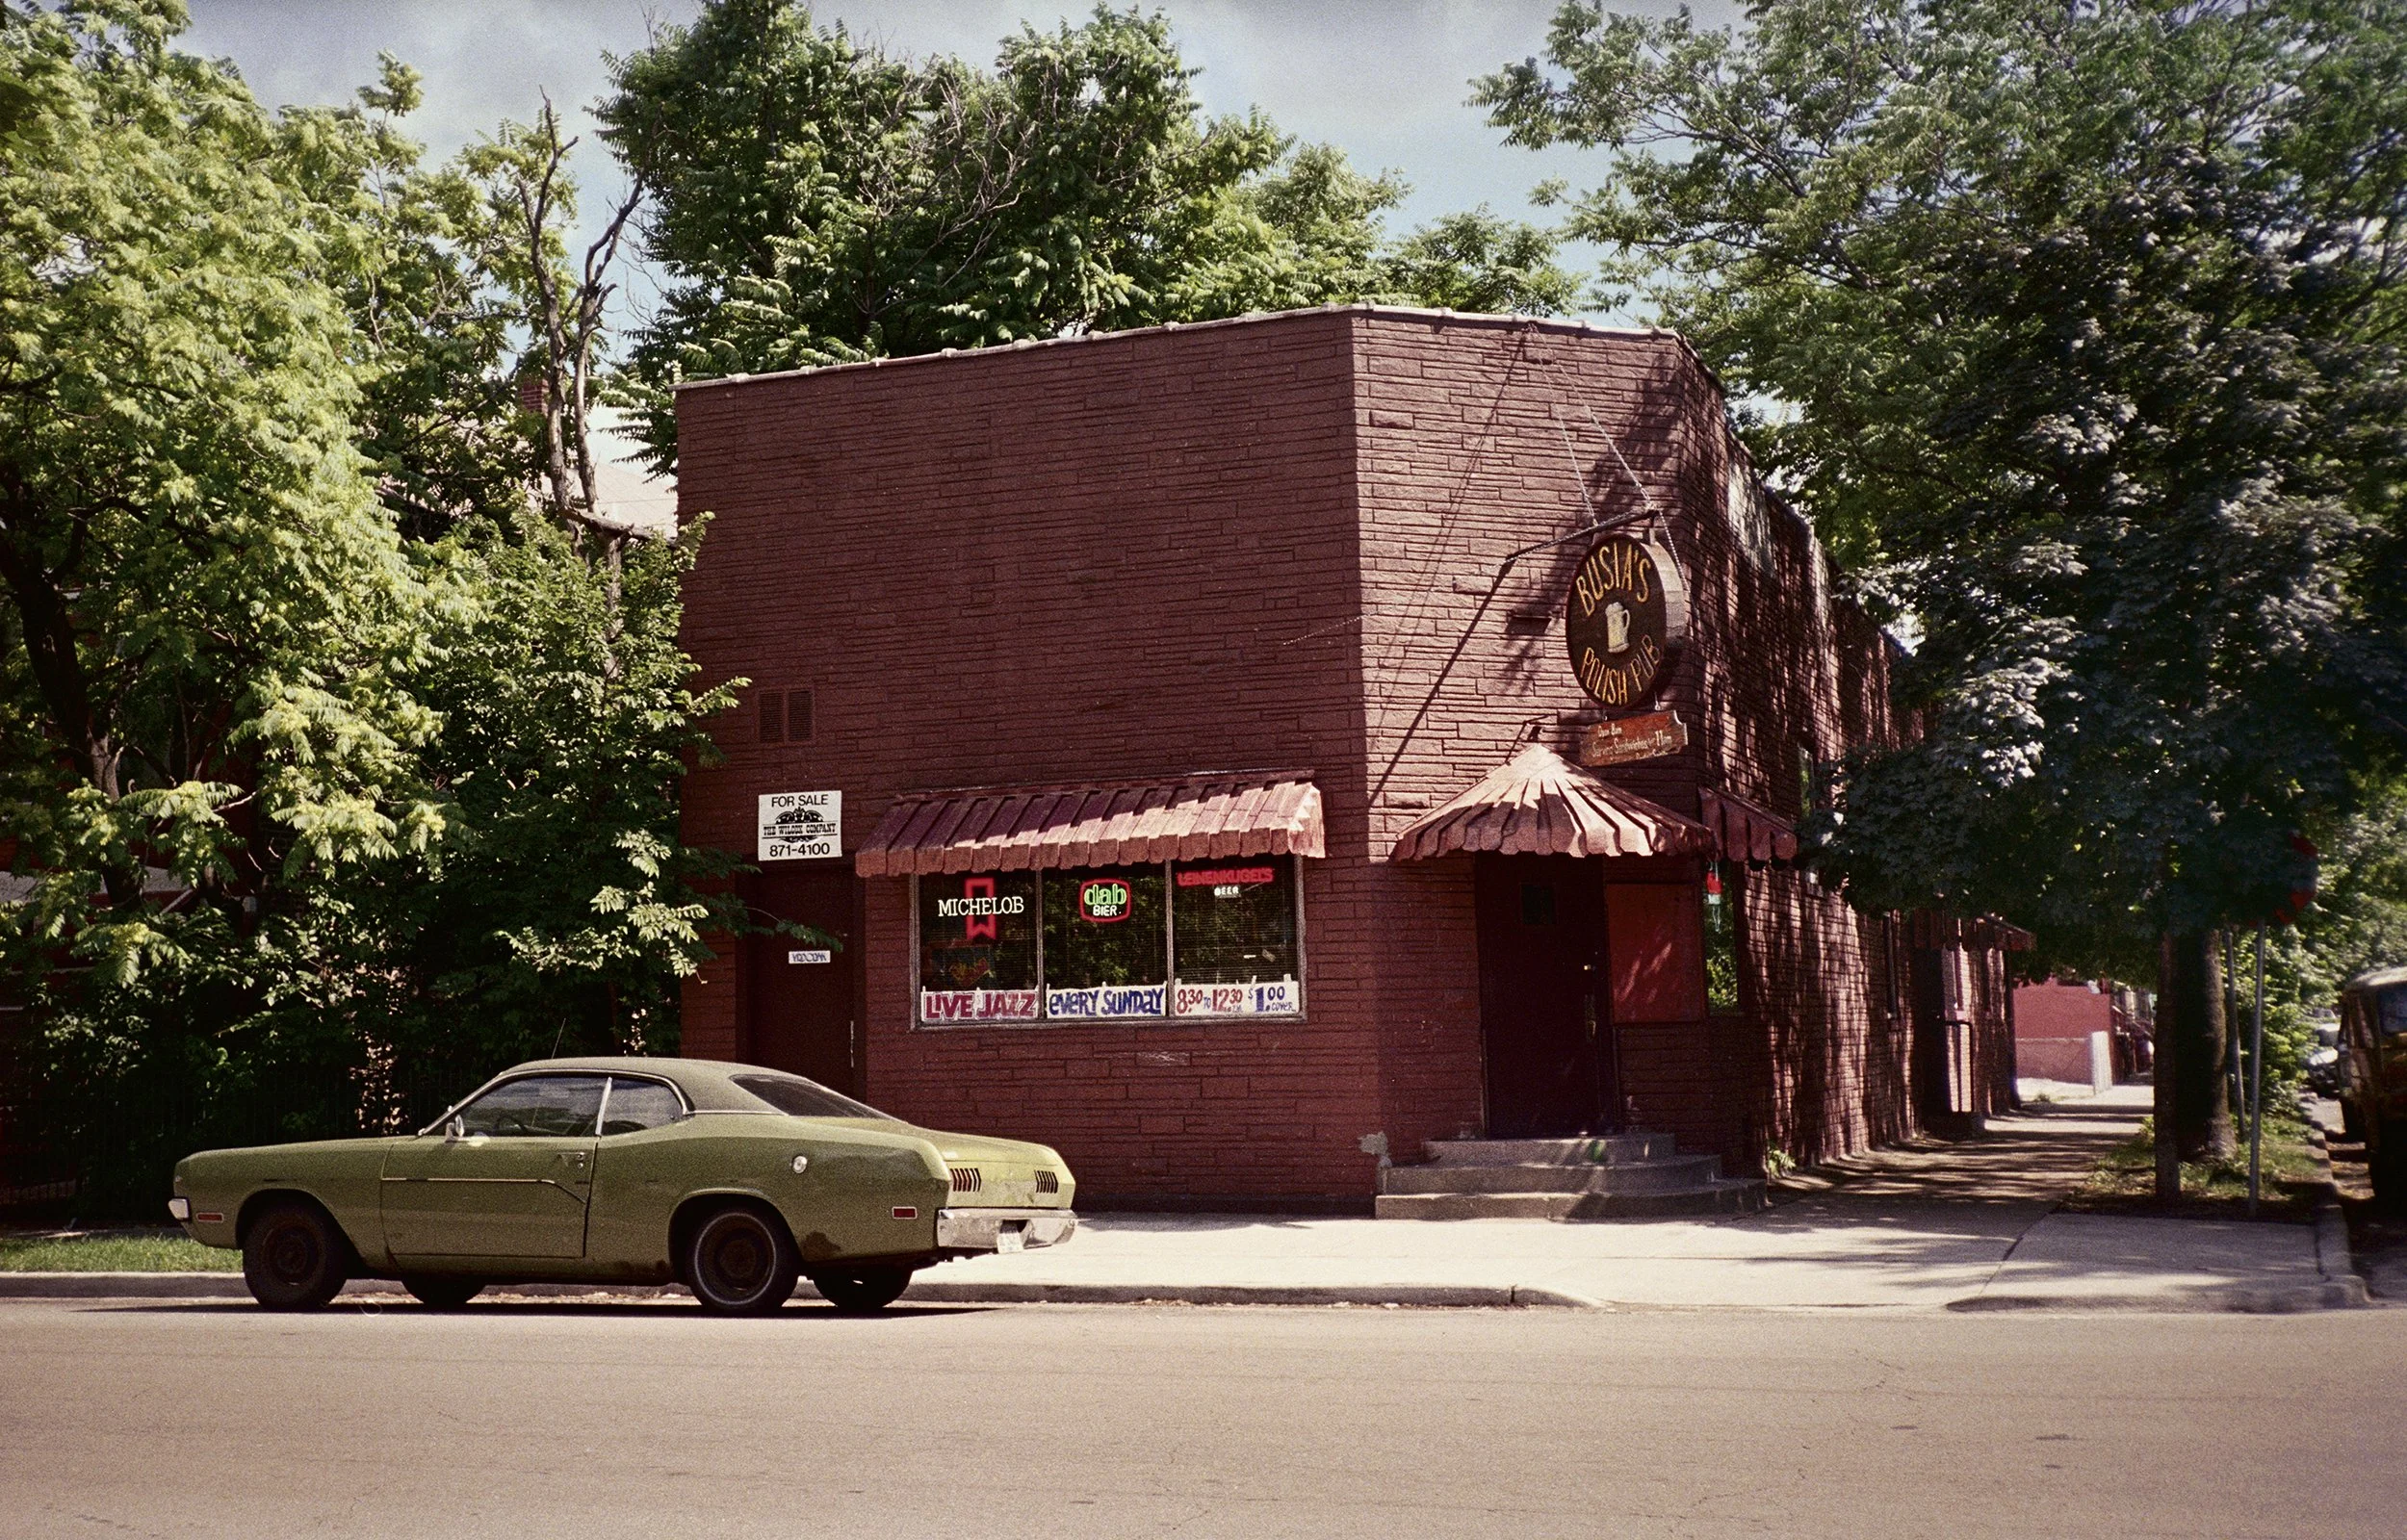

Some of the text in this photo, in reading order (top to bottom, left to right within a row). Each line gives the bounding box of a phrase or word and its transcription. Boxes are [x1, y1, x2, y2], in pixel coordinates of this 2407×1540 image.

[1576, 542, 1652, 616] BUSIA'S
[1580, 634, 1661, 706] POLISH PUB
[771, 794, 828, 808] FOR SALE
[806, 823, 837, 834] COMPANY
[769, 842, 830, 857] 871-4100
[1084, 884, 1126, 906] dab
[1214, 886, 1239, 896] BEER
[938, 896, 1024, 916] MICHELOB
[1093, 905, 1118, 916] BIER
[925, 992, 1036, 1018] LIVE JAZZ
